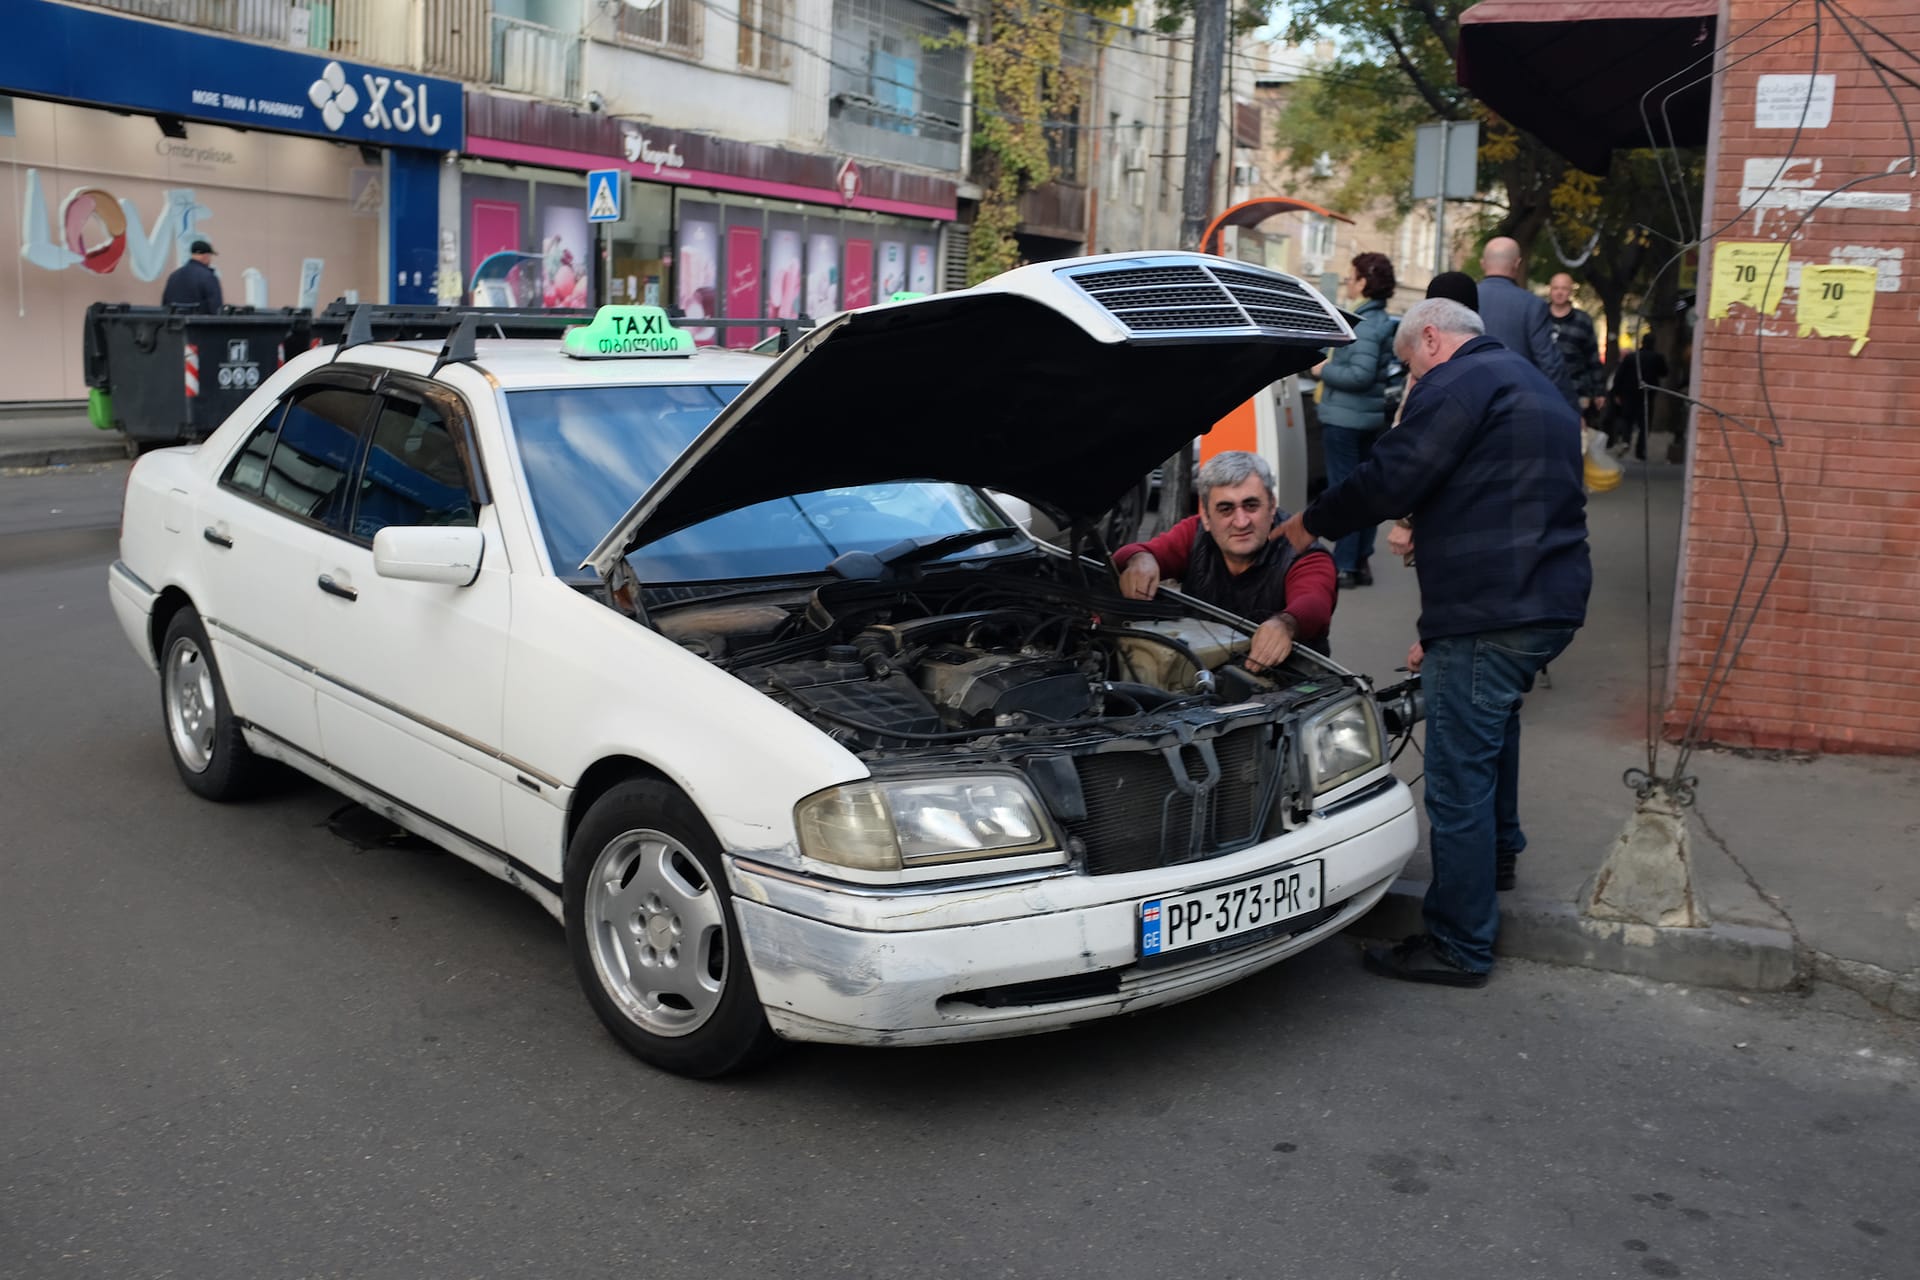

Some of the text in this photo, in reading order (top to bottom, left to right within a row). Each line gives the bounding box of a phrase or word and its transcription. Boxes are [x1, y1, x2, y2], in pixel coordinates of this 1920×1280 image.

[192, 90, 305, 119] MORE THAN A PHARMACY
[1735, 265, 1757, 283] 70
[1821, 282, 1845, 300] 70
[612, 315, 663, 335] TAXI
[598, 337, 678, 353] თბილისი
[1168, 873, 1301, 945] PP-373-PR
[1143, 931, 1161, 949] GE
